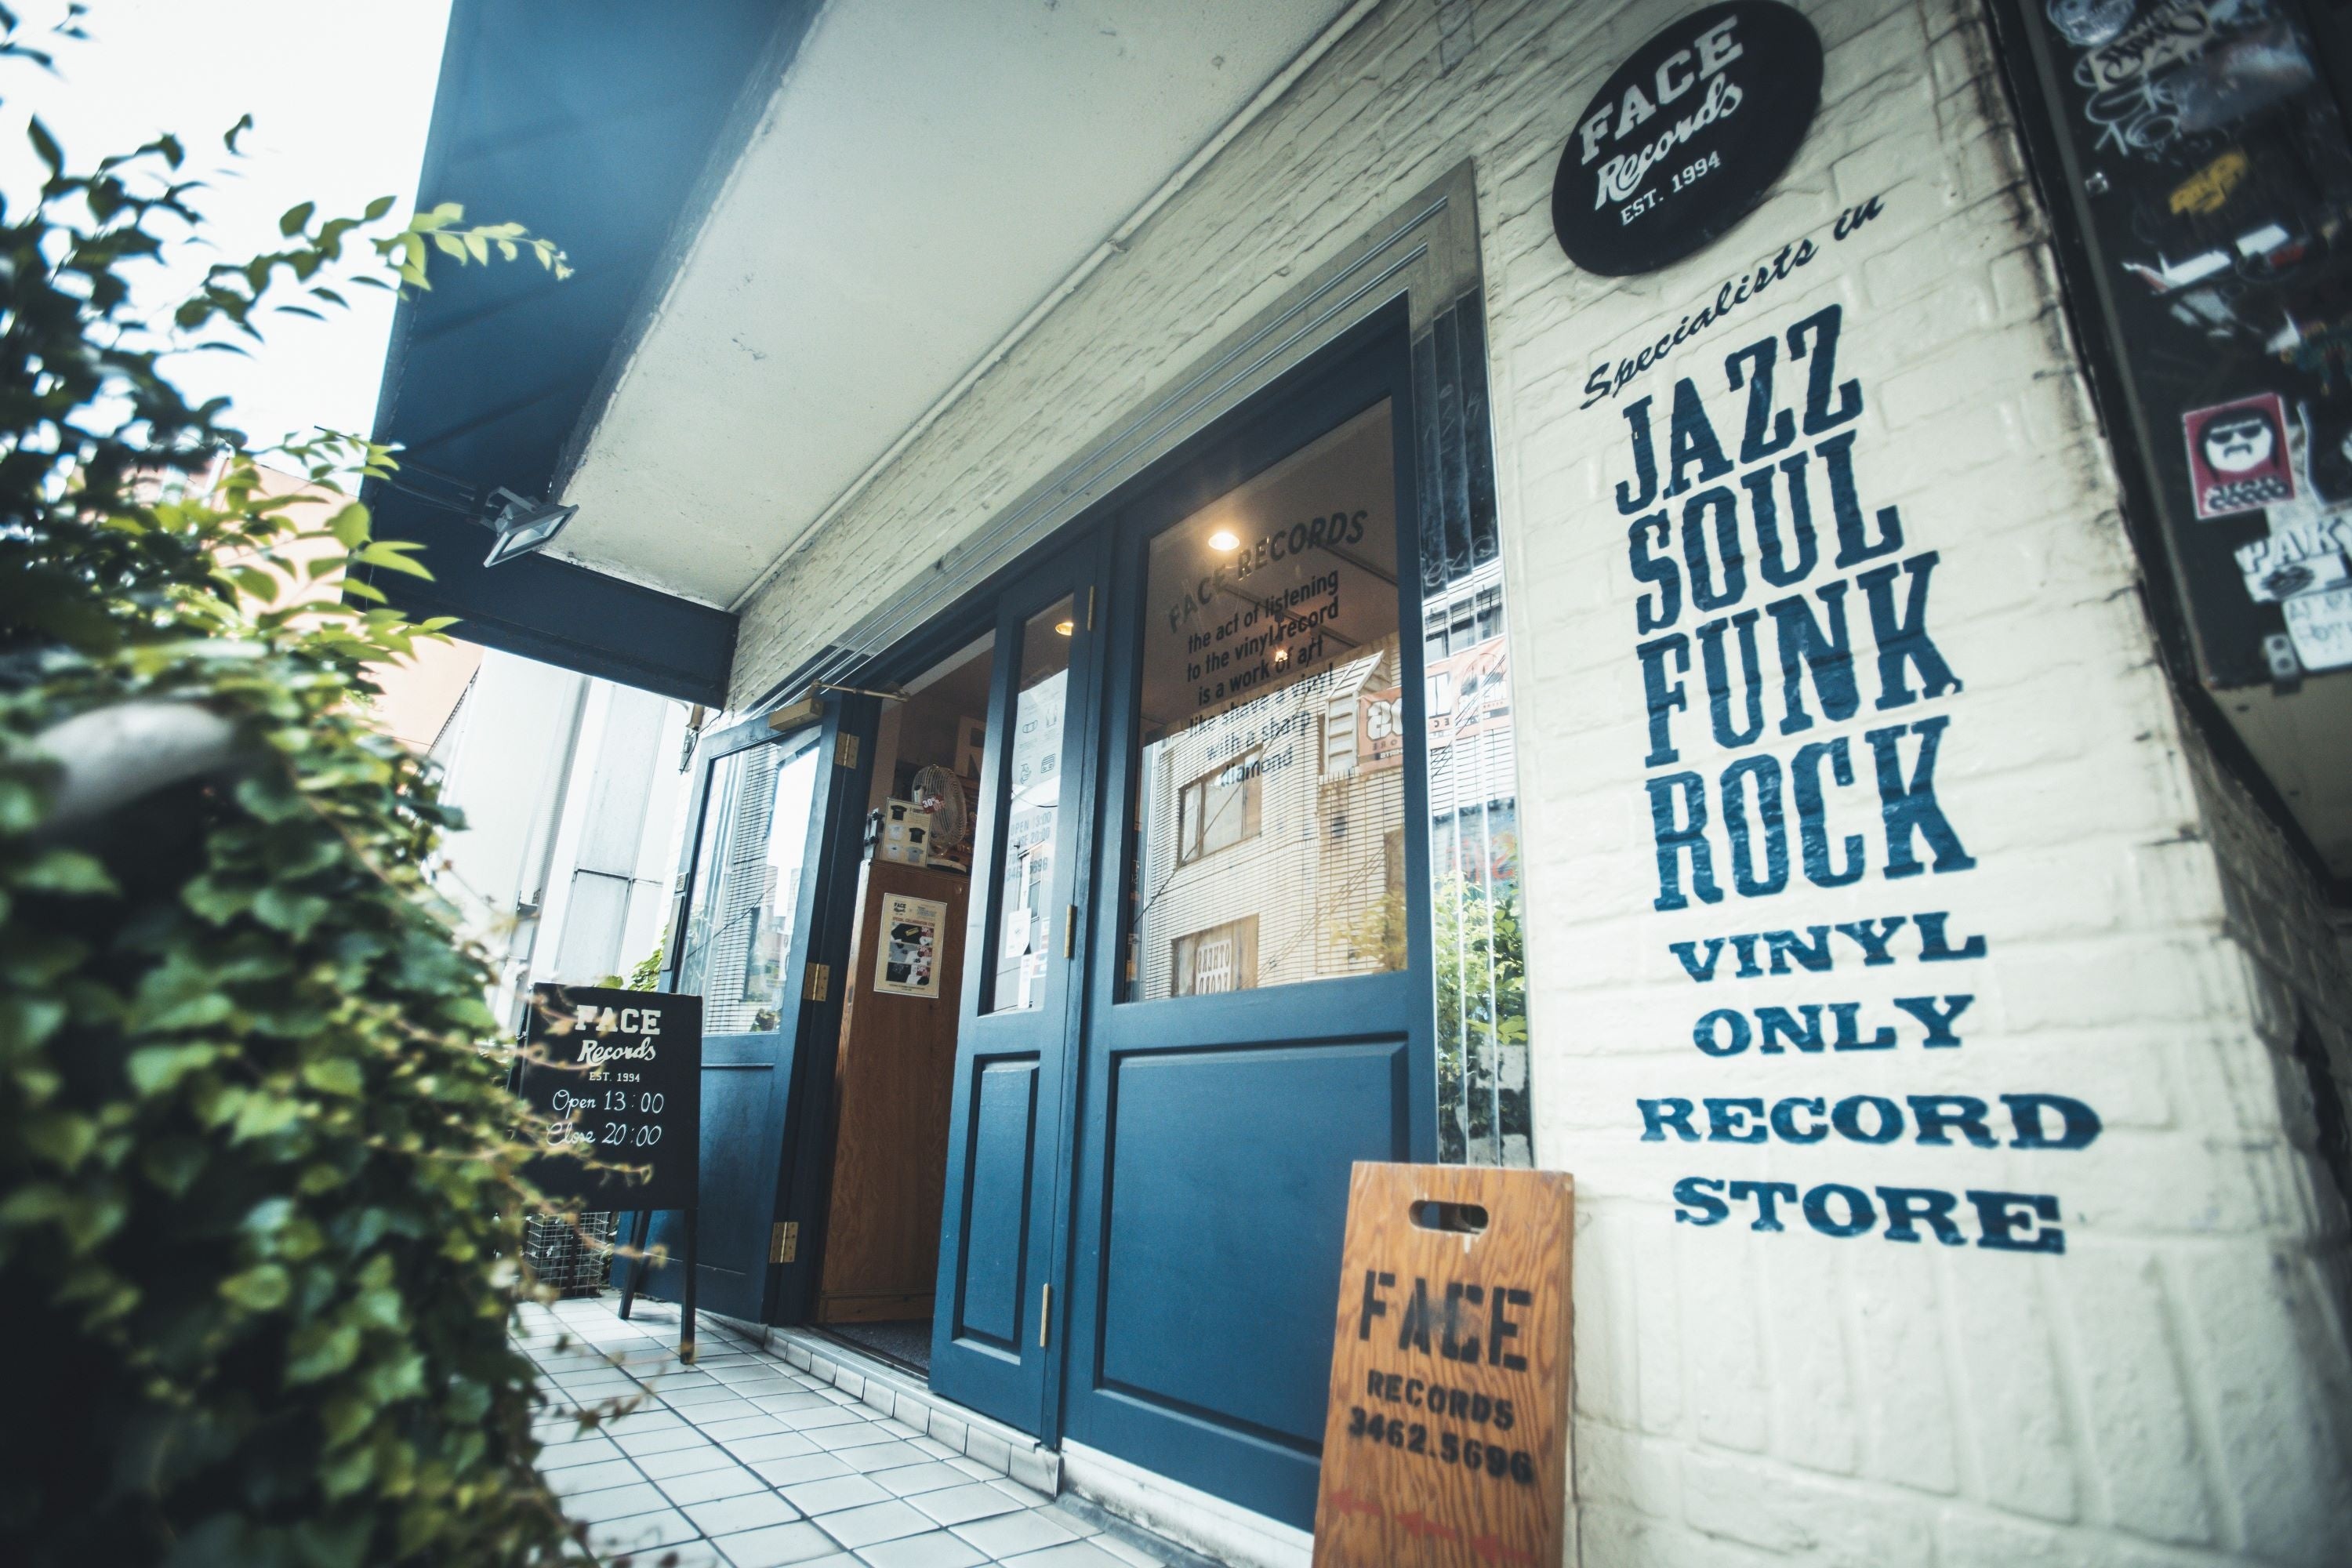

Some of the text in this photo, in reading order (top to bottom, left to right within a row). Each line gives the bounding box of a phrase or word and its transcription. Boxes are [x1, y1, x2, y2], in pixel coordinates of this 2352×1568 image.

[1579, 14, 1744, 165] FACE
[1594, 71, 1744, 210] Records
[1621, 150, 1722, 226] EST. 1994
[1580, 194, 1886, 410] Specialists in
[1615, 303, 1864, 515] JAZZ
[1628, 428, 1904, 636] SOUL
[1169, 564, 1229, 634] FACE
[1238, 510, 1368, 581] RECORDS
[1187, 596, 1338, 682] to the vinyl record
[1188, 570, 1338, 654] the act of listening
[1199, 634, 1323, 706] is a work of art
[1635, 550, 1963, 769] FUNK
[1189, 714, 1216, 739] like
[1293, 662, 1334, 698] vinyl
[1261, 710, 1311, 743] sharp
[1219, 743, 1294, 787] diamond
[1011, 820, 1029, 836] OPEN
[1030, 827, 1051, 844] 20:00
[1645, 714, 1977, 912] ROCK
[1668, 911, 1987, 983] VINYL
[575, 1004, 661, 1035] FACE
[577, 1036, 656, 1066] Records
[1693, 994, 1975, 1057] ONLY
[553, 1089, 596, 1120] Open
[589, 1072, 641, 1083] EST. 1994
[546, 1122, 596, 1146] Close
[1636, 1094, 2103, 1151] RECORD
[1673, 1176, 2066, 1255] STORE
[1359, 1269, 1532, 1372] FACE
[1367, 1370, 1515, 1432] RECORDS
[1349, 1406, 1534, 1484] 3462.5696
